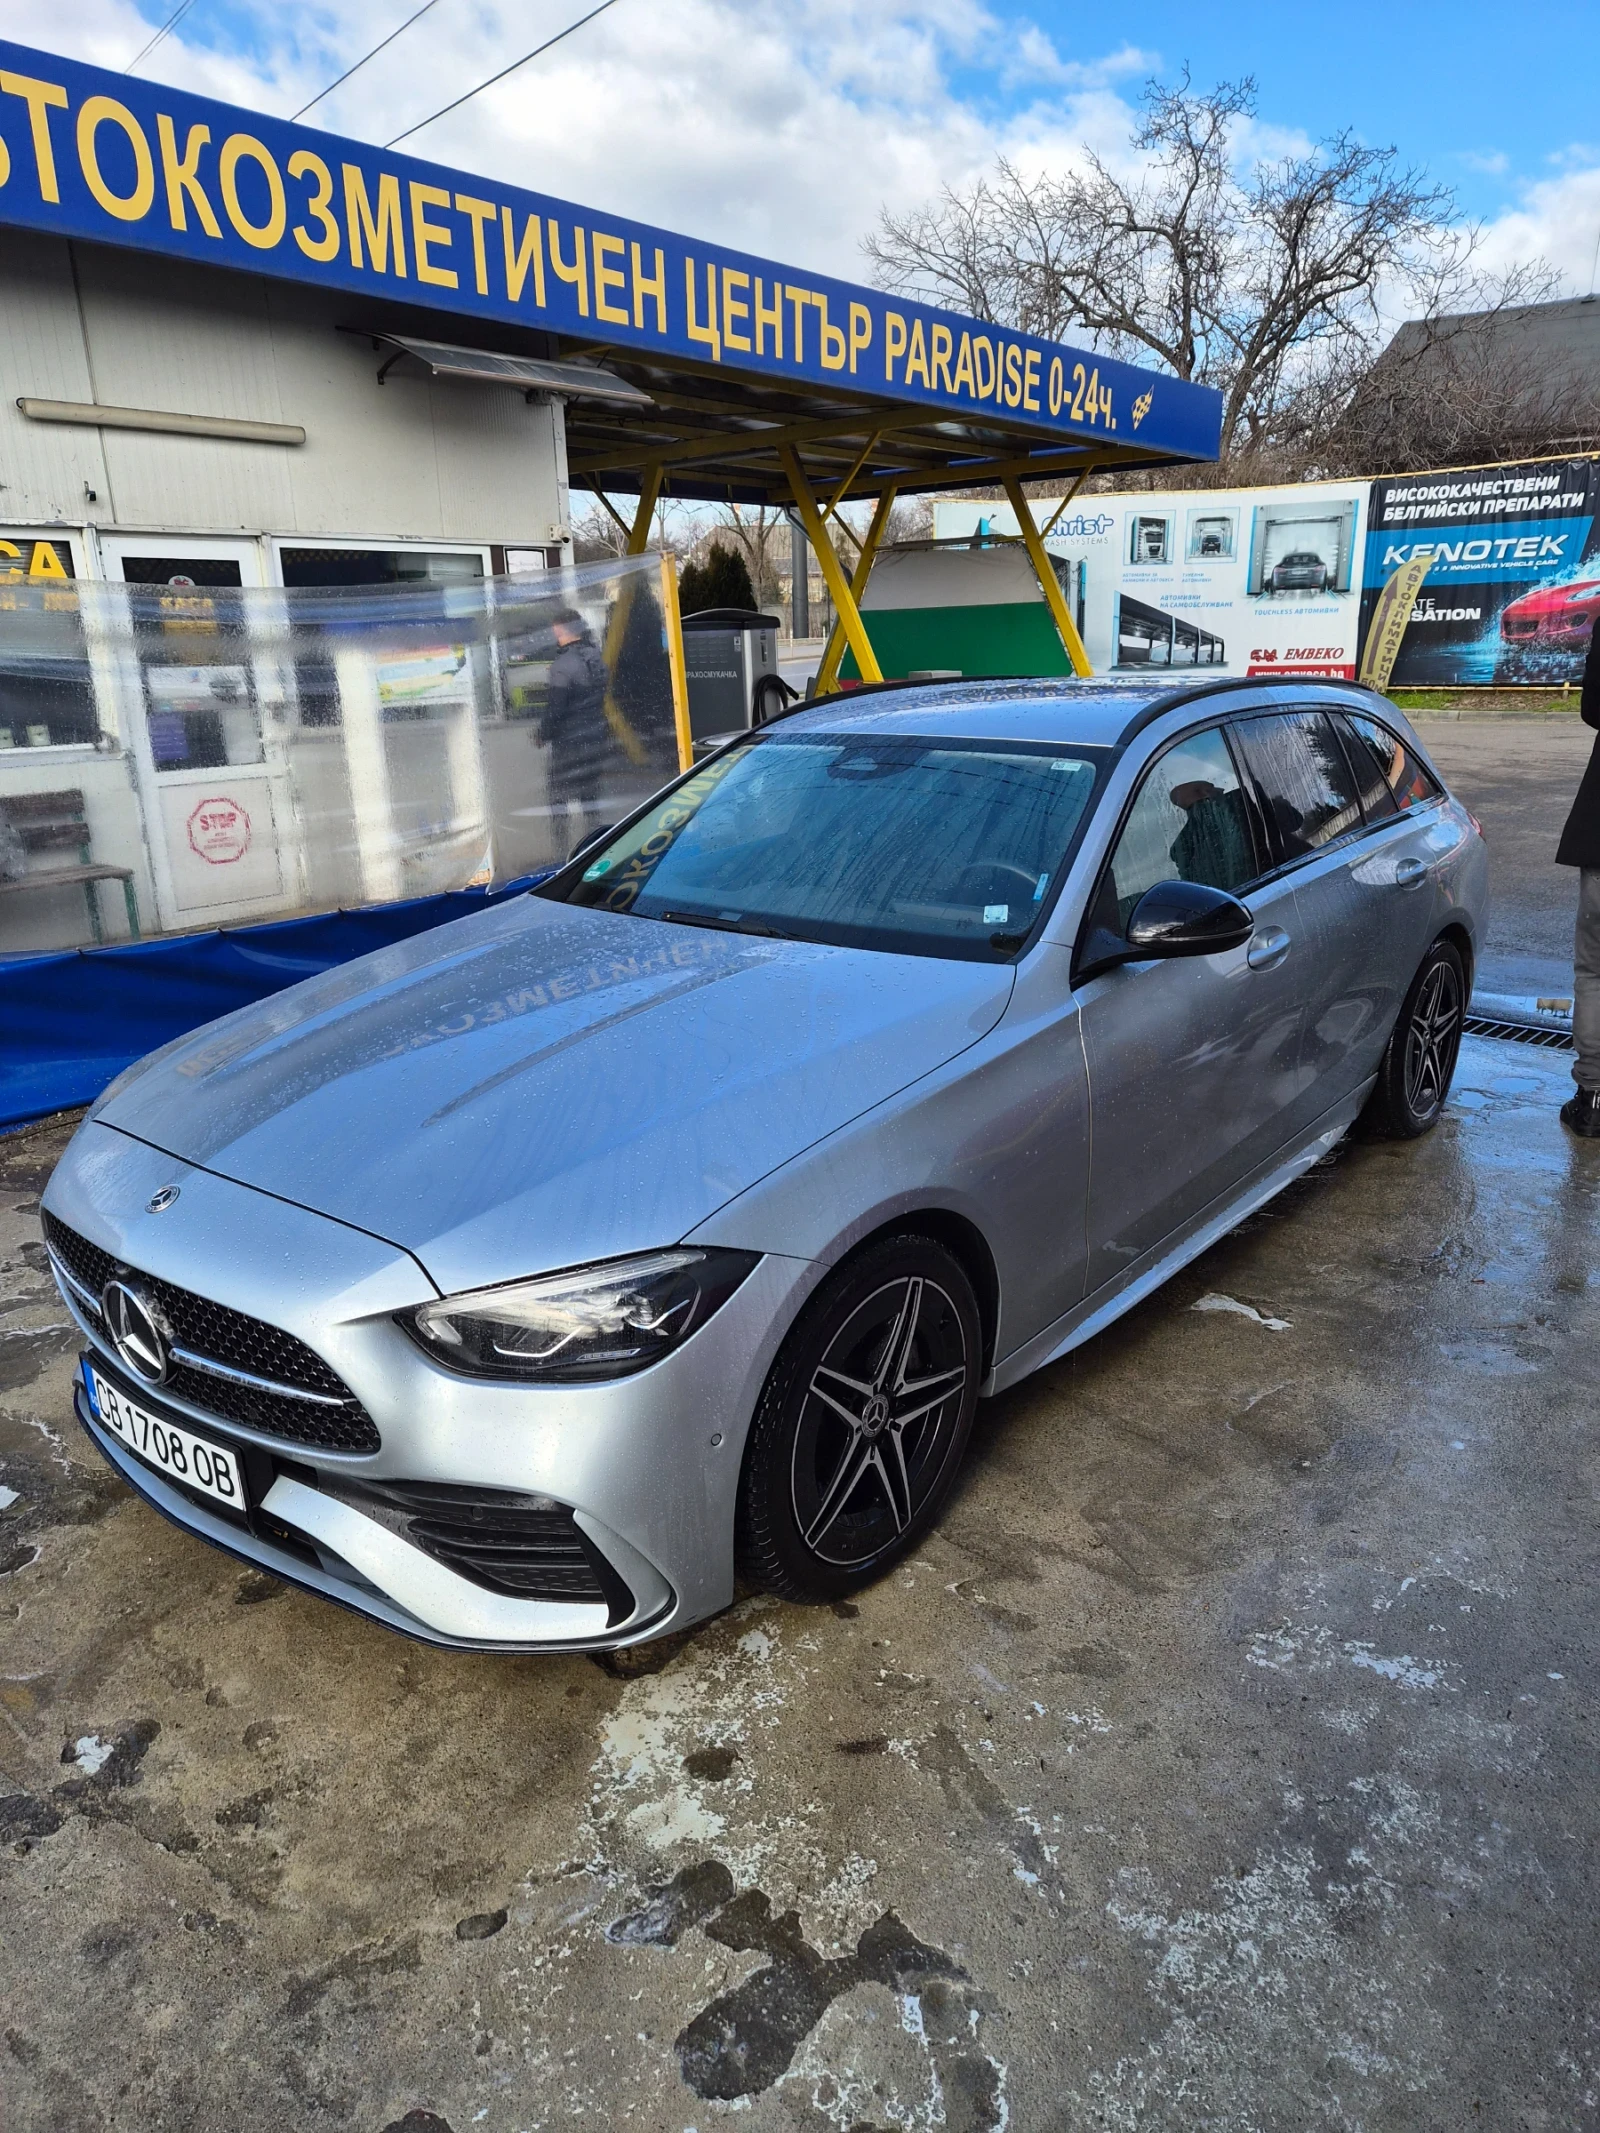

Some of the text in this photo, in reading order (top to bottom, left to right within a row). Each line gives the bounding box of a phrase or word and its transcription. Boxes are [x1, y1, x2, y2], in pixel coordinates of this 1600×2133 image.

[0, 69, 1117, 430] ТОКОЗМЕТИЧЕН ЦЕНТЪР PARADISE 0-24ч.
[1384, 475, 1560, 504] ВИСОКОКАЧЕСТВЕНИ
[1383, 492, 1585, 521] БЕЛГИЙСКИ ПРЕПАРАТИ
[1041, 513, 1114, 537] Christ
[1070, 536, 1109, 546] SYSTEMS
[1382, 534, 1569, 565] KENOTEK
[1450, 563, 1498, 571] INNOVATIVE
[1254, 608, 1293, 616] TOUCHLESS
[1377, 564, 1422, 683] АВТОКЛИМАТИЦИ
[1408, 608, 1481, 621] SATION
[685, 670, 738, 679] РАХОСМУКАЧКА
[125, 1405, 188, 1475] 1708
